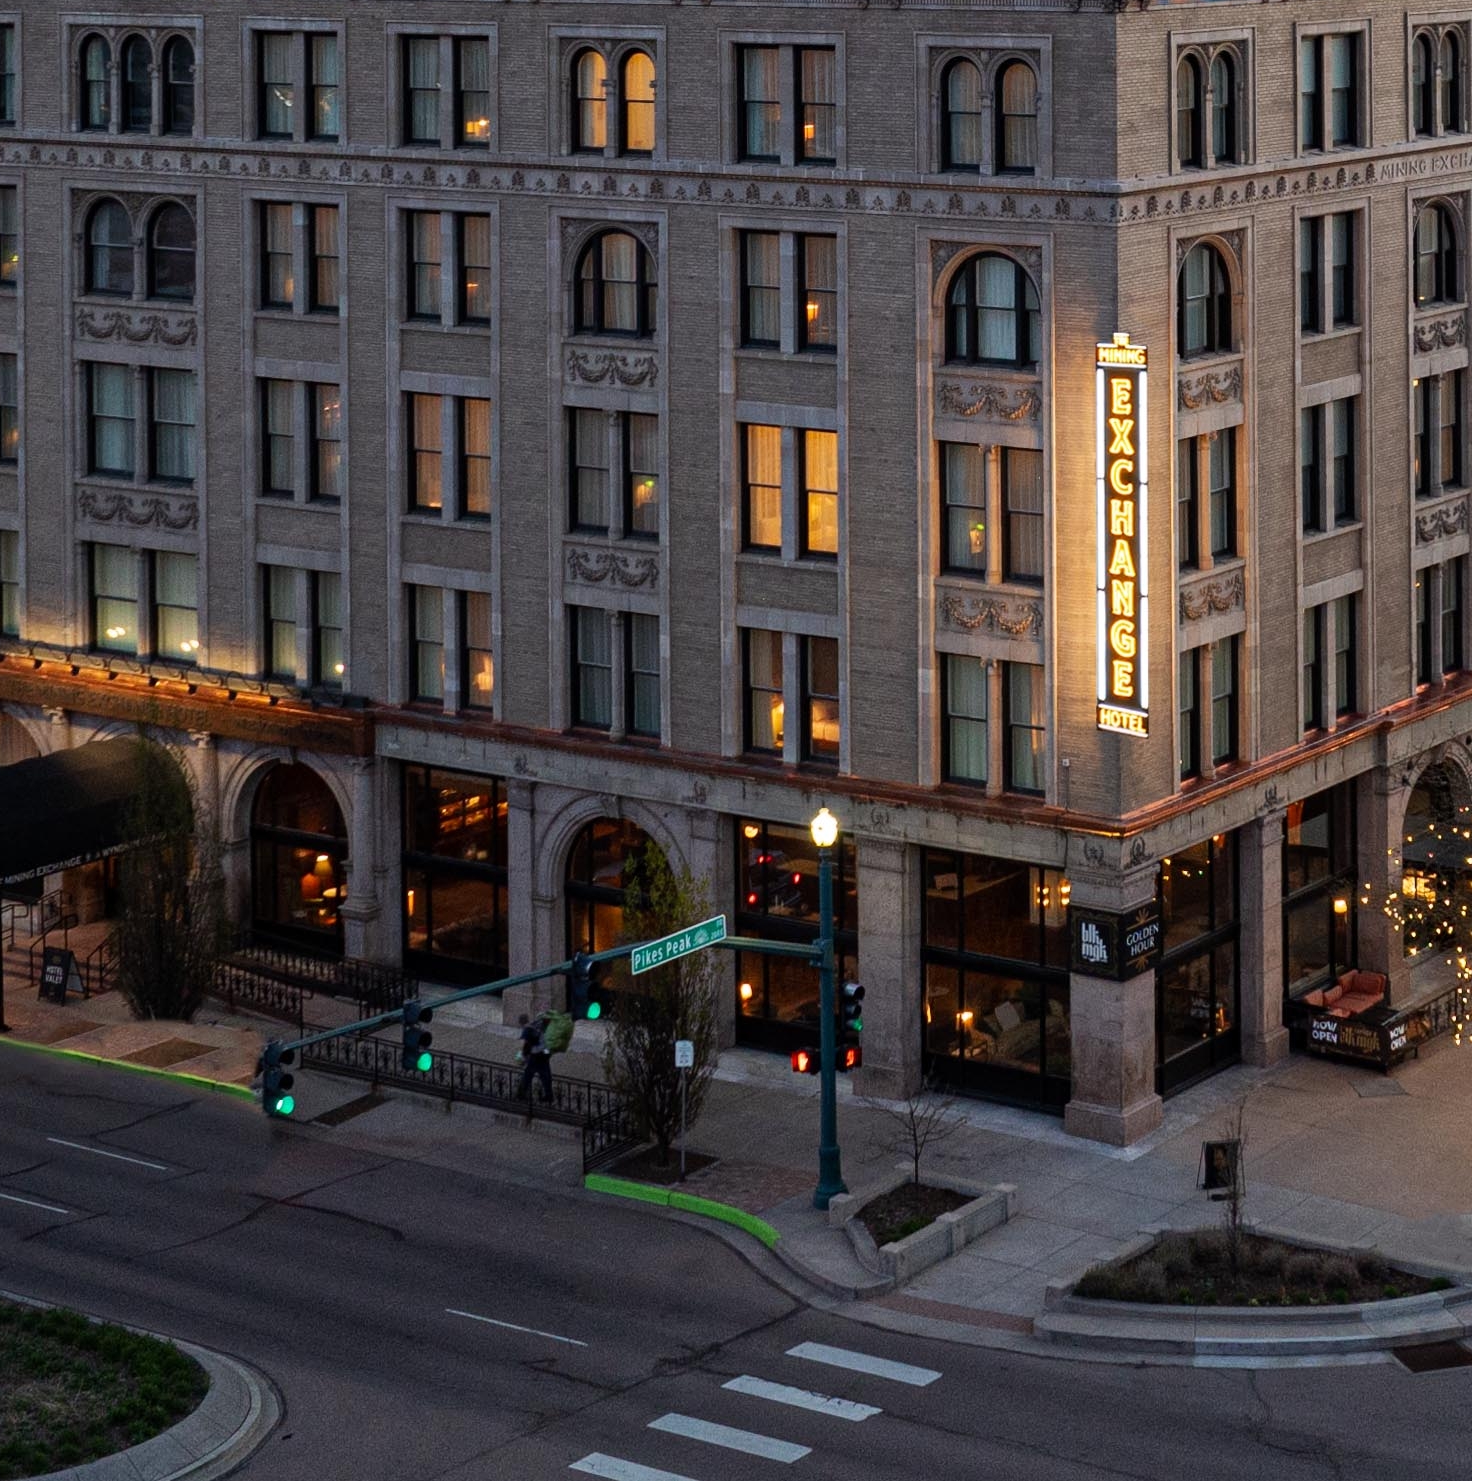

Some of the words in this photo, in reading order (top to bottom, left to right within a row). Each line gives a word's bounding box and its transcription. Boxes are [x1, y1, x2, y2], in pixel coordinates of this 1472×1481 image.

[1098, 348, 1146, 364] MINING
[1109, 377, 1136, 698] EXCHANGE
[1099, 709, 1146, 733] HOTEL
[4, 869, 35, 884] MINING
[36, 856, 81, 877] EXCHANGE
[1126, 922, 1159, 946] GOLDEN
[1131, 936, 1155, 956] HOUR
[635, 947, 663, 969] Pikes
[666, 933, 691, 957] Peak
[1312, 1031, 1337, 1044] OPEN
[1313, 1020, 1337, 1032] NOW
